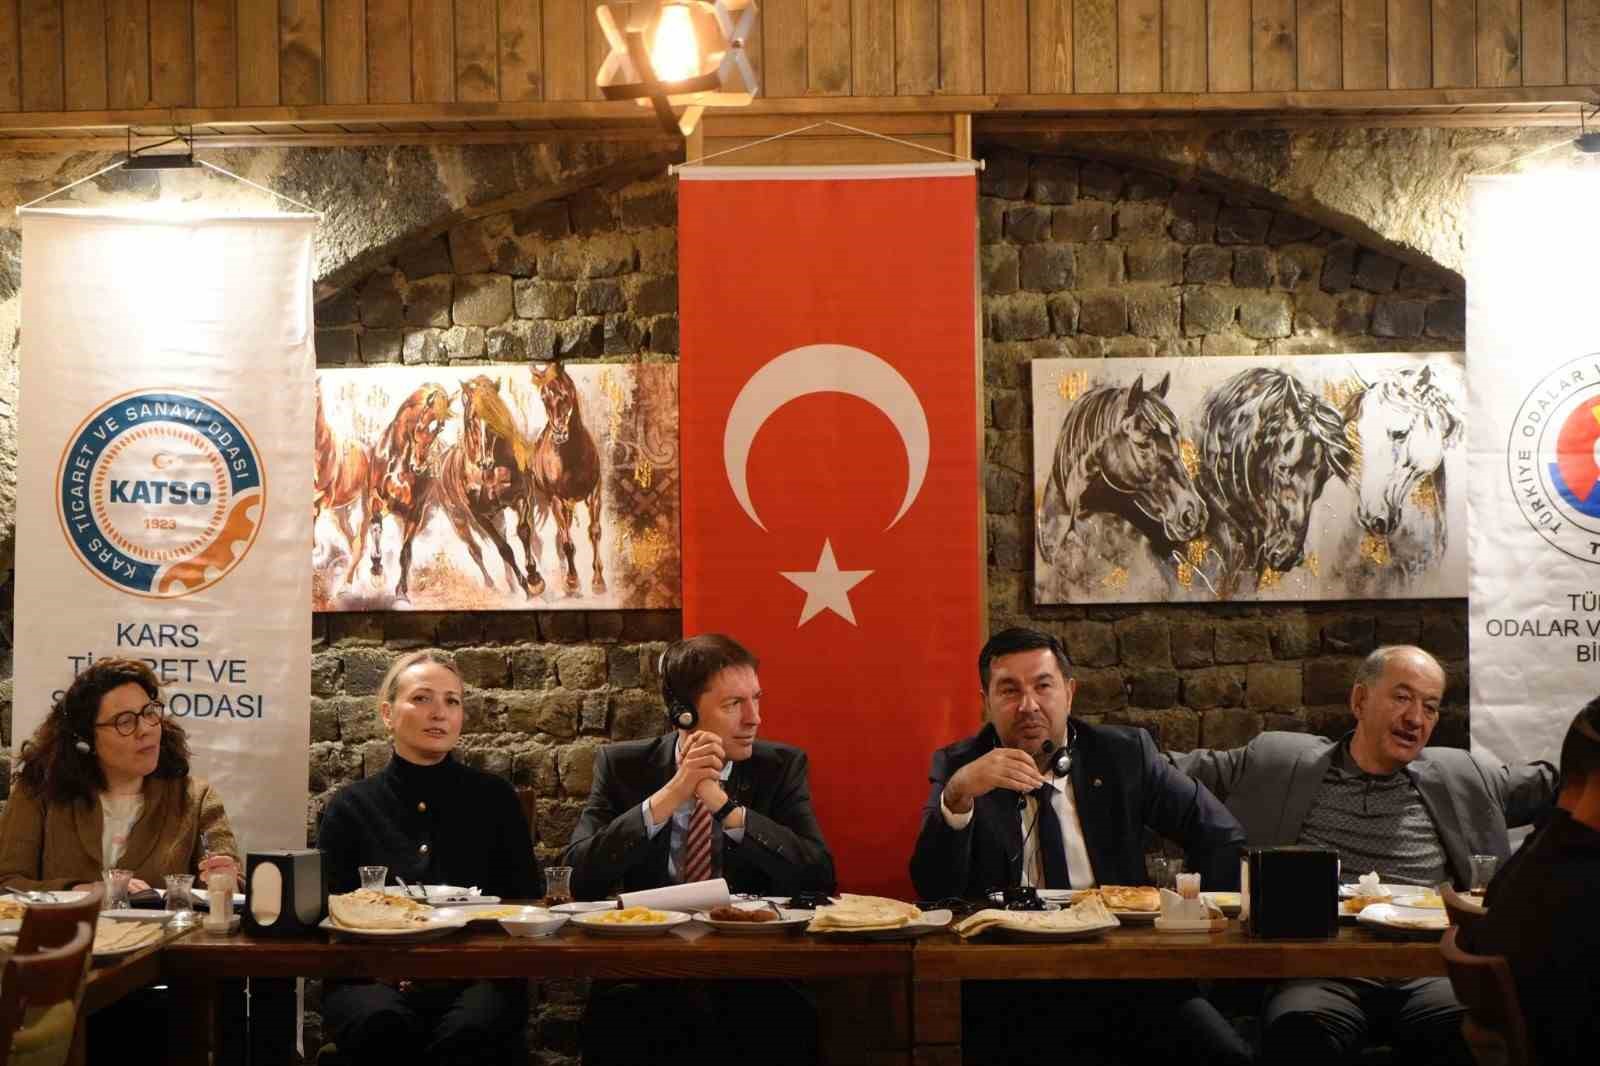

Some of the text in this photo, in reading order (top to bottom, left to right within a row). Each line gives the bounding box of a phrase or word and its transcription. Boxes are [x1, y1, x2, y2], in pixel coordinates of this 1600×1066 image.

[1519, 370, 1585, 535] TÜRKİYE ODALAR
[71, 402, 249, 579] KARS TİCARET VE SANAYİ ODASI
[110, 480, 211, 505] KATSO
[144, 518, 177, 530] 1923
[1567, 591, 1600, 612] TÜ
[117, 623, 199, 648] KARS
[1486, 619, 1581, 637] ODALAR
[1577, 641, 1600, 663] Bİ
[67, 652, 247, 683] TİET VE
[169, 694, 263, 719] ODASI
